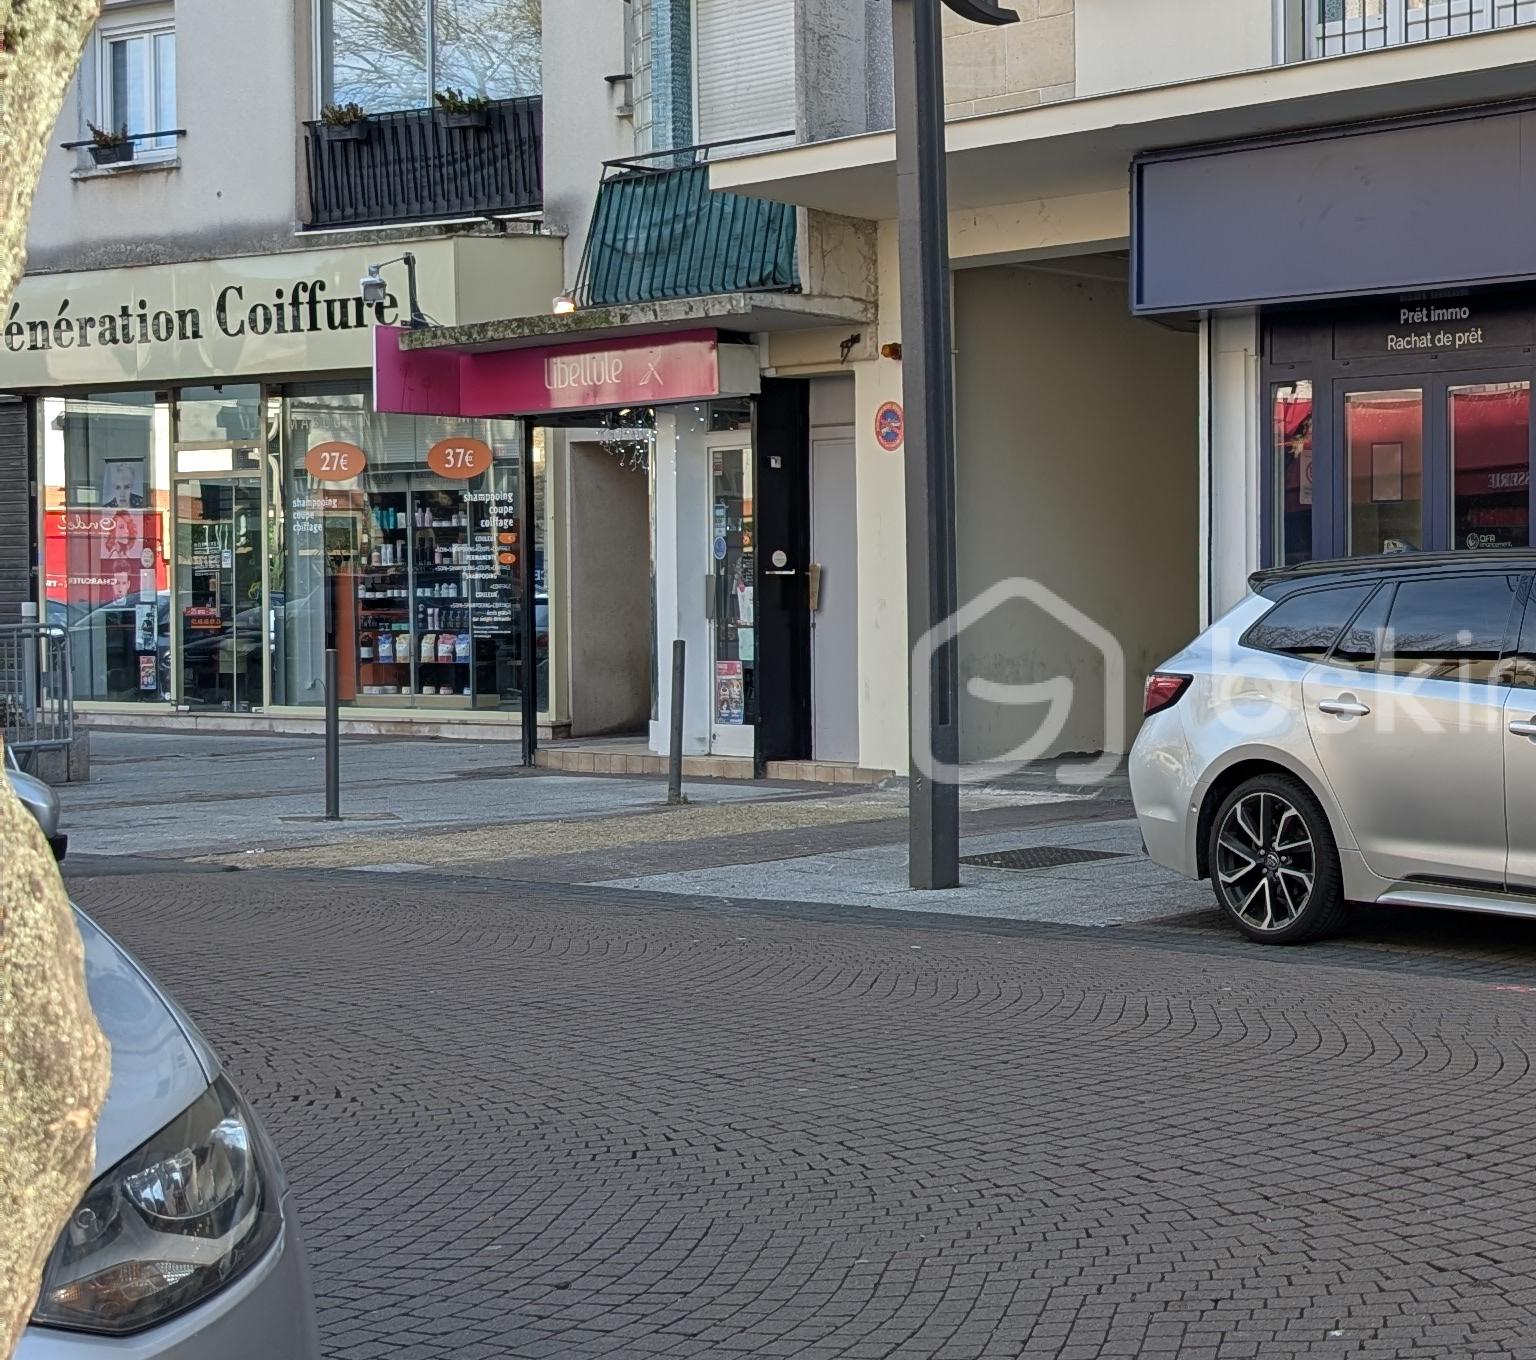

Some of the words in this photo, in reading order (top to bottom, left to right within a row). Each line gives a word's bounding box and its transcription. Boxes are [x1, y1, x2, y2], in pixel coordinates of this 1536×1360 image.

[0, 298, 203, 352] énération
[216, 279, 400, 338] Coiffure
[1400, 306, 1428, 324] Prêt
[1430, 305, 1470, 321] immo
[1387, 331, 1432, 350] Rachat
[1435, 330, 1452, 346] de
[1455, 328, 1483, 349] prêt
[320, 452, 349, 471] 27€
[444, 448, 474, 468] 37€
[292, 494, 338, 509] shampooing
[463, 491, 514, 504] shampooing
[292, 510, 316, 521] coupe
[488, 506, 514, 516] coupe
[480, 516, 514, 529] coiffage
